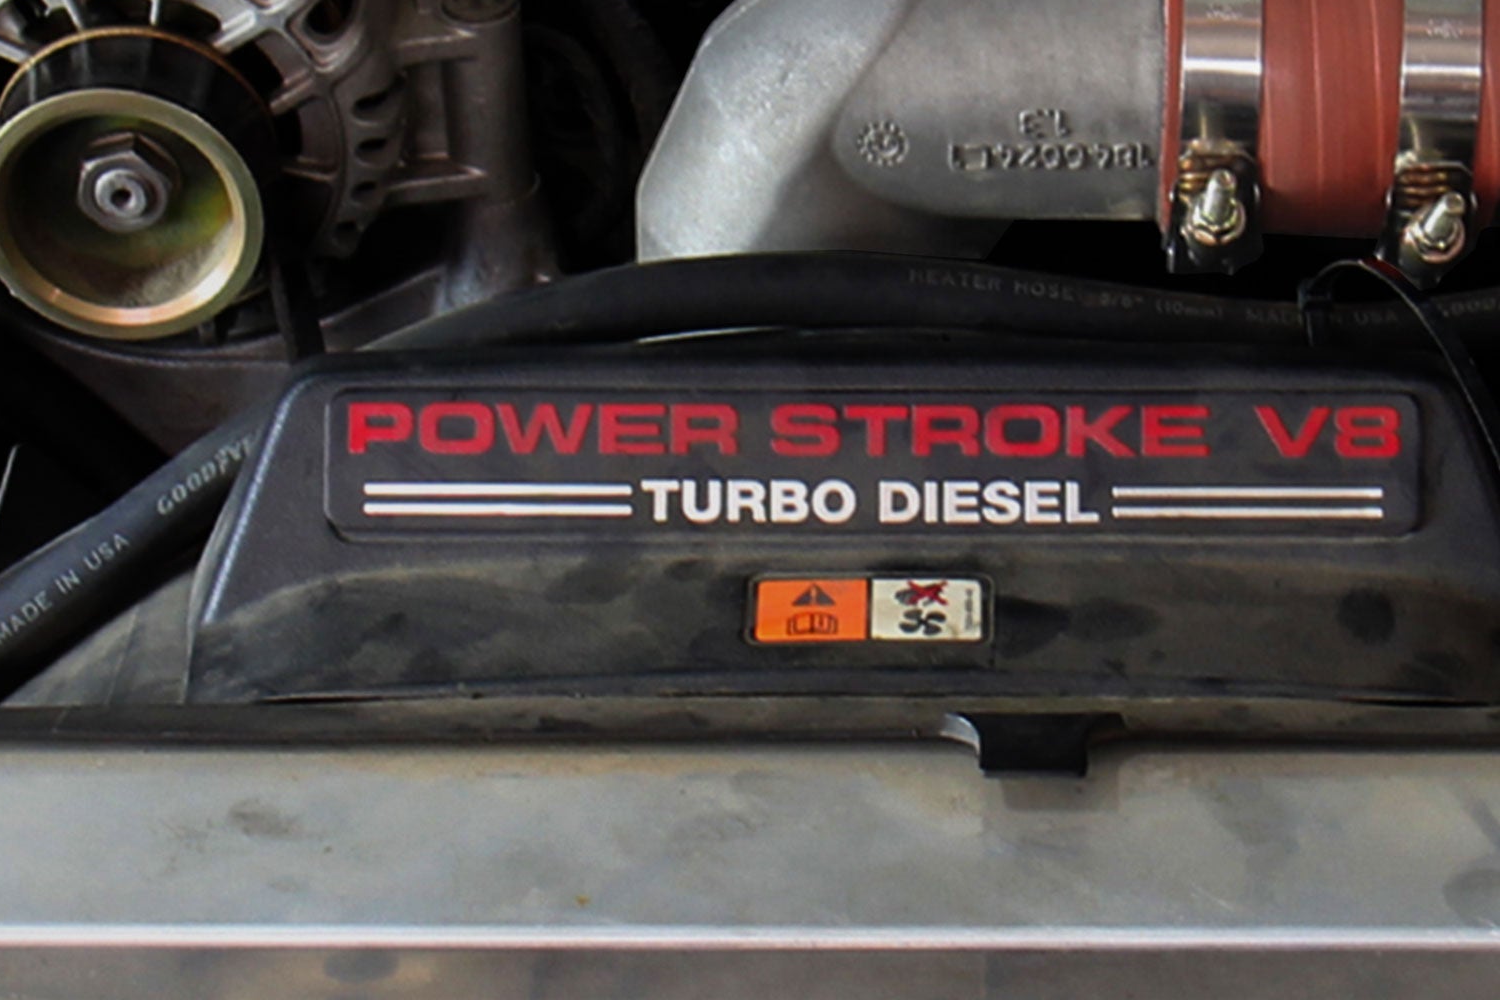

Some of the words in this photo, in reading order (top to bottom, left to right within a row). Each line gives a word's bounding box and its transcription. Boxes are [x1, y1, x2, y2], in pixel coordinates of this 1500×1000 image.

[908, 267, 1000, 292] HEATER
[1013, 278, 1076, 302] HOSE
[348, 401, 739, 456] POWER
[771, 402, 1211, 458] STROKE
[1255, 405, 1403, 459] V8
[640, 479, 857, 523] TURBO
[878, 480, 1101, 524] DIESEL
[54, 568, 81, 595] IN
[83, 533, 131, 571] USA
